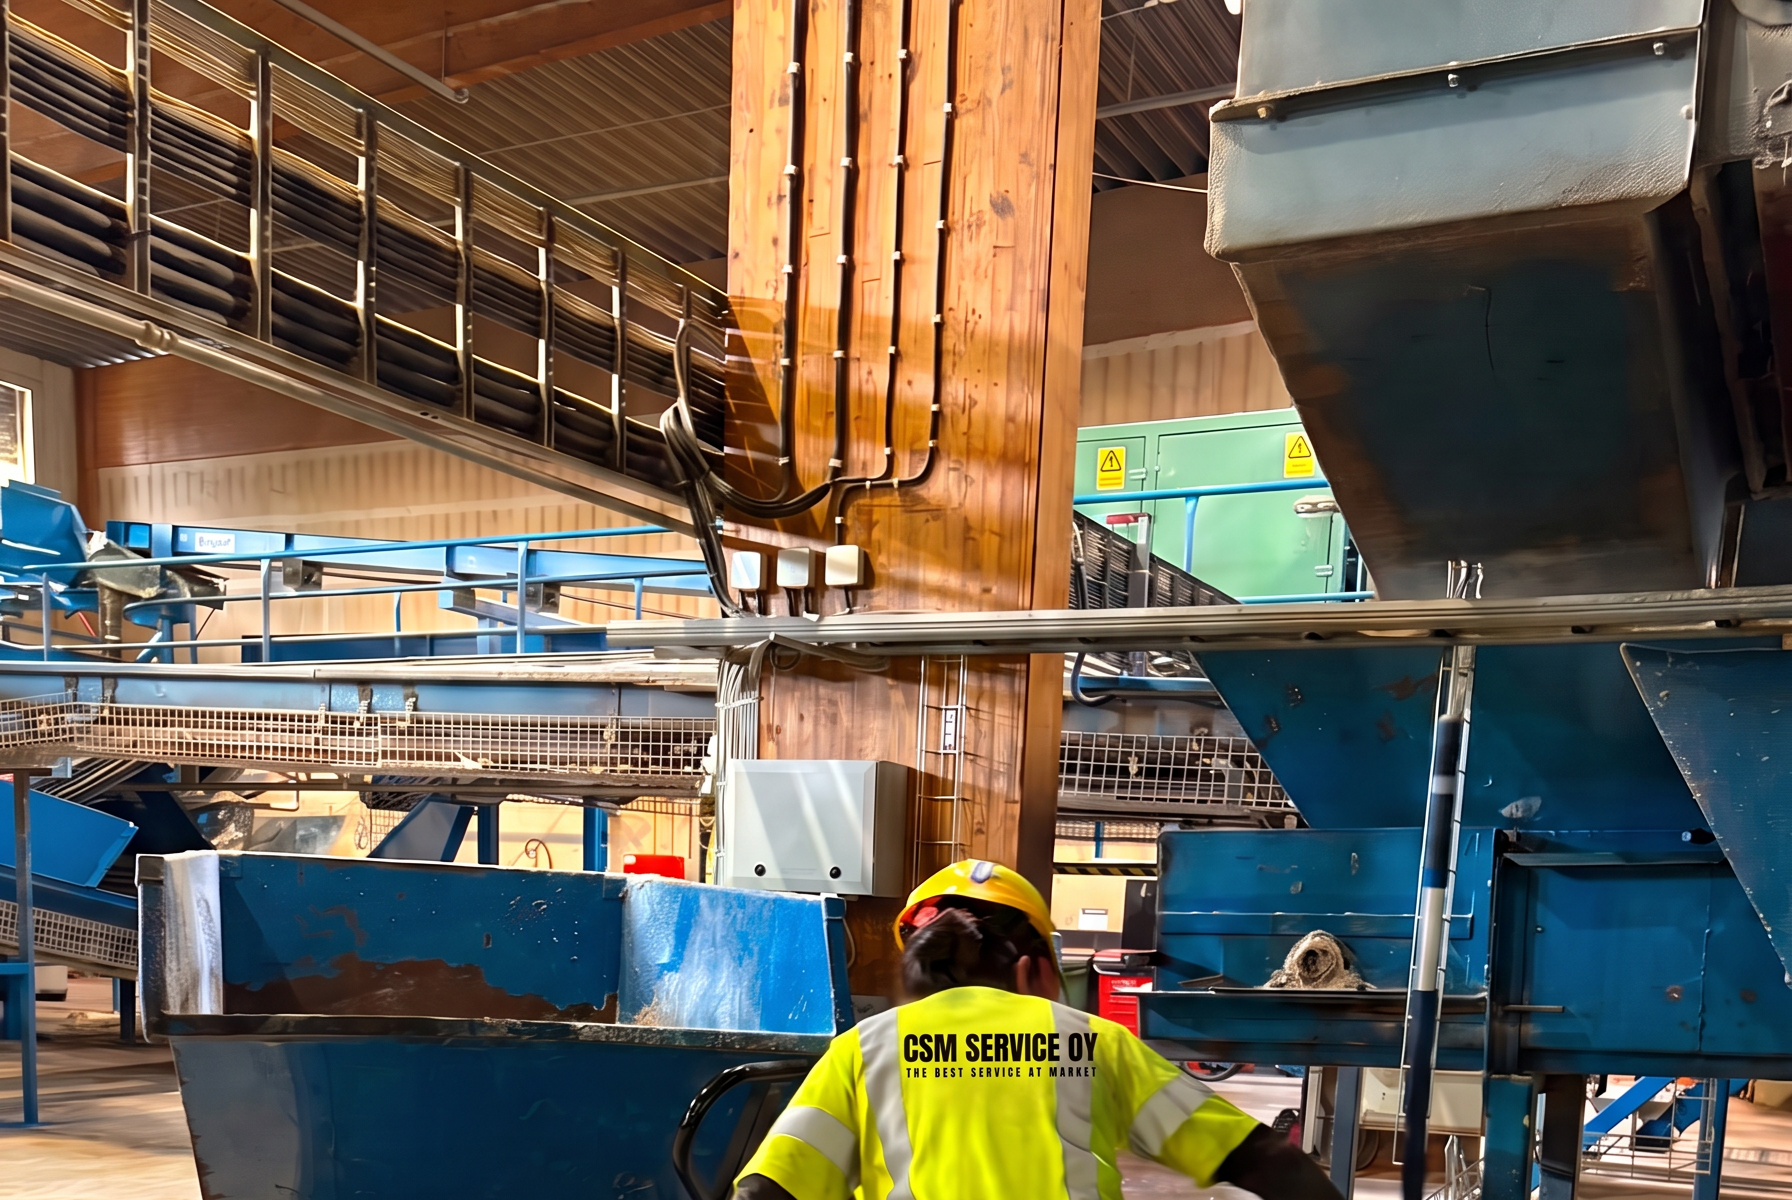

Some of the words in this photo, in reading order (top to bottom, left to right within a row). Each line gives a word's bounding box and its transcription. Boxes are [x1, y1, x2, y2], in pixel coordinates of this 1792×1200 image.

[903, 1033, 957, 1063] CSM
[965, 1032, 1061, 1063] SERVICE
[1068, 1032, 1099, 1062] OY
[906, 1067, 928, 1079] THE
[934, 1067, 964, 1078] BEST
[970, 1066, 1021, 1078] SERVICE
[1028, 1066, 1042, 1078] AT
[1048, 1066, 1097, 1078] MARKET
